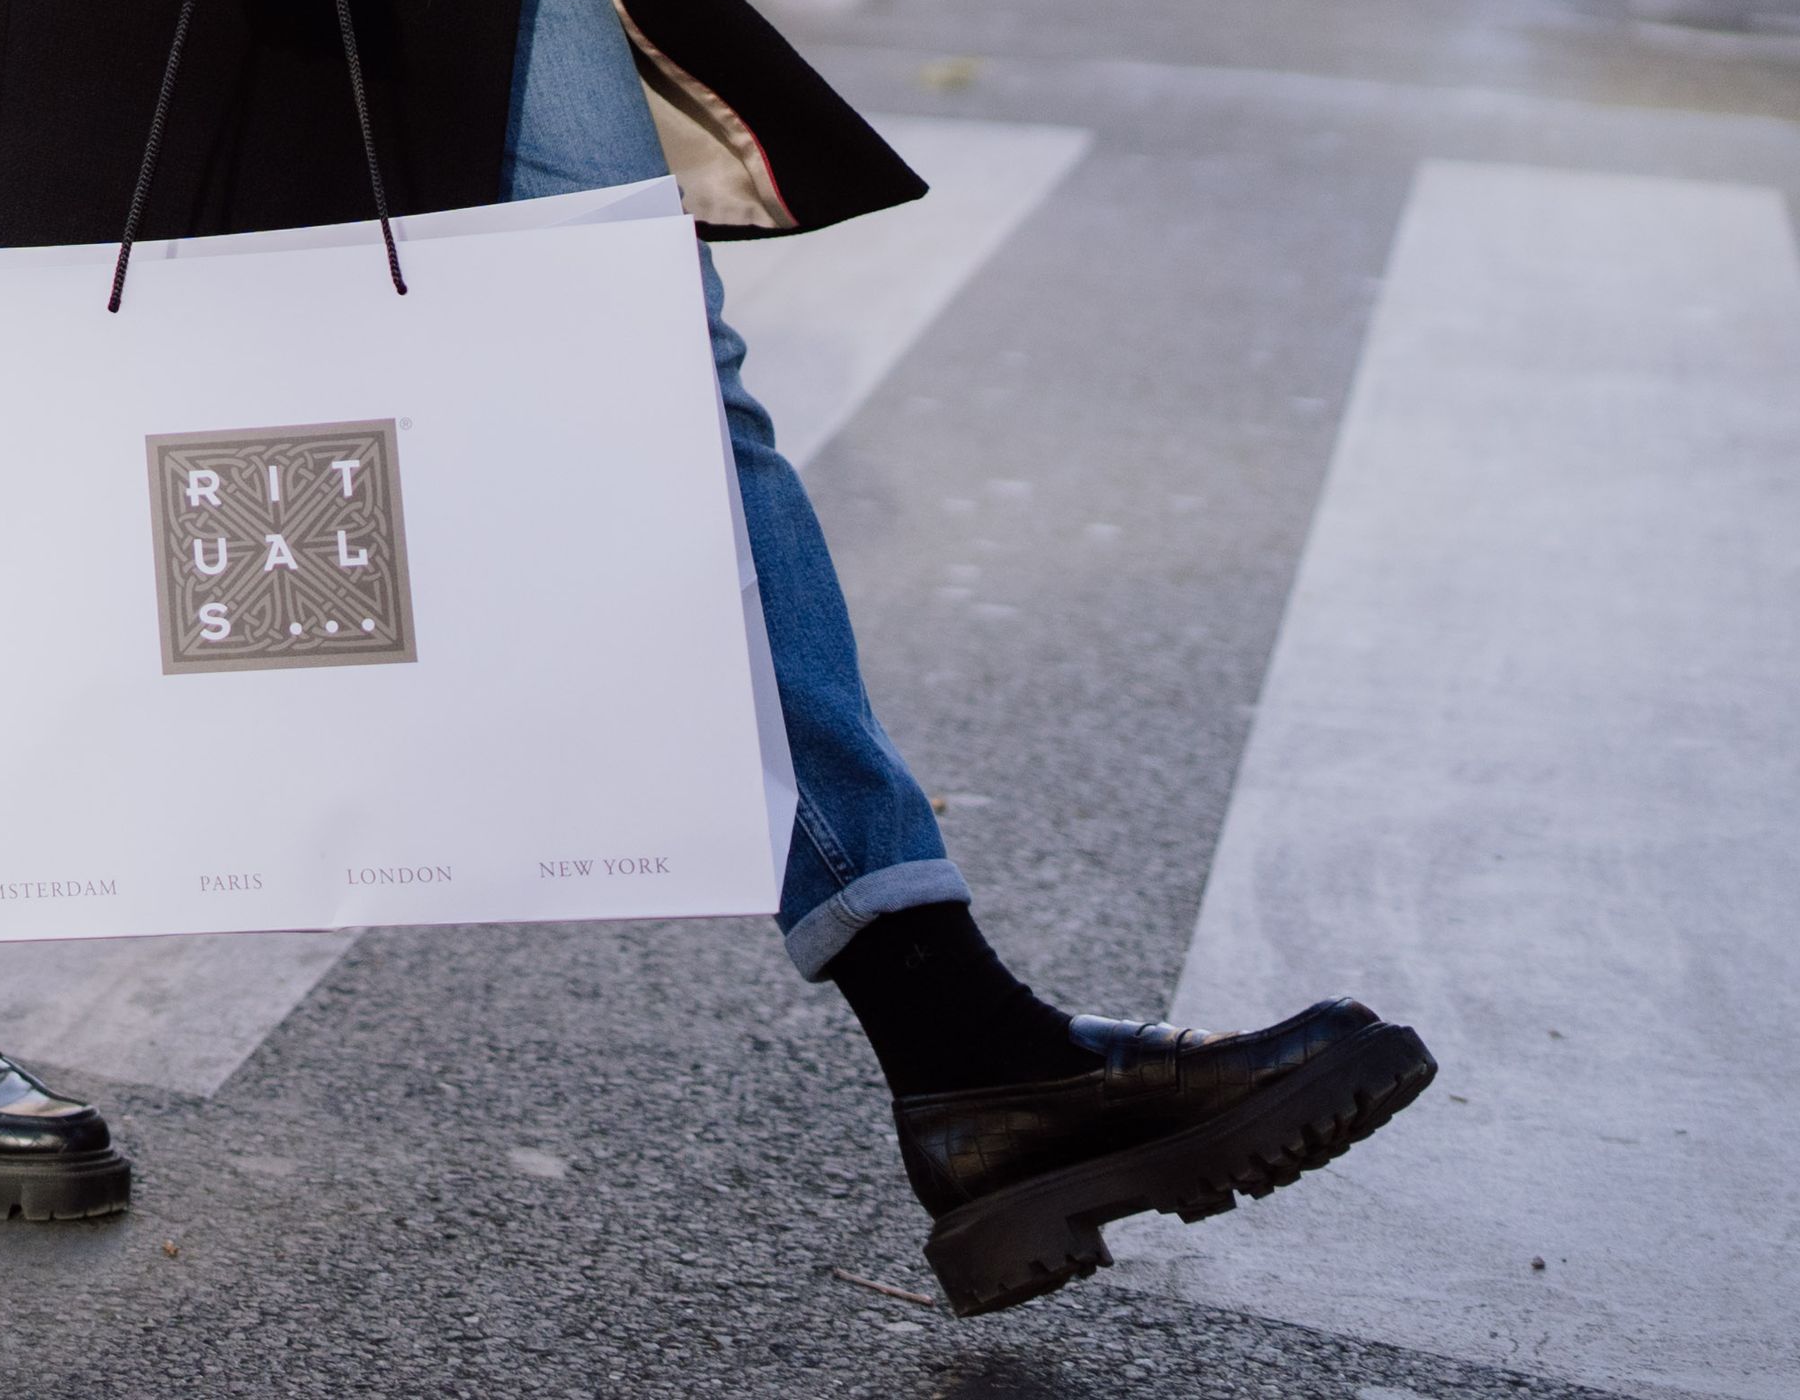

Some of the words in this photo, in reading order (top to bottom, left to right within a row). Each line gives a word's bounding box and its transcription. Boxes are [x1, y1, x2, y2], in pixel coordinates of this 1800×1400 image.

[199, 873, 264, 892] PARIS
[347, 866, 453, 885] LONDON
[538, 859, 595, 878] NEW
[602, 856, 671, 875] YORK
